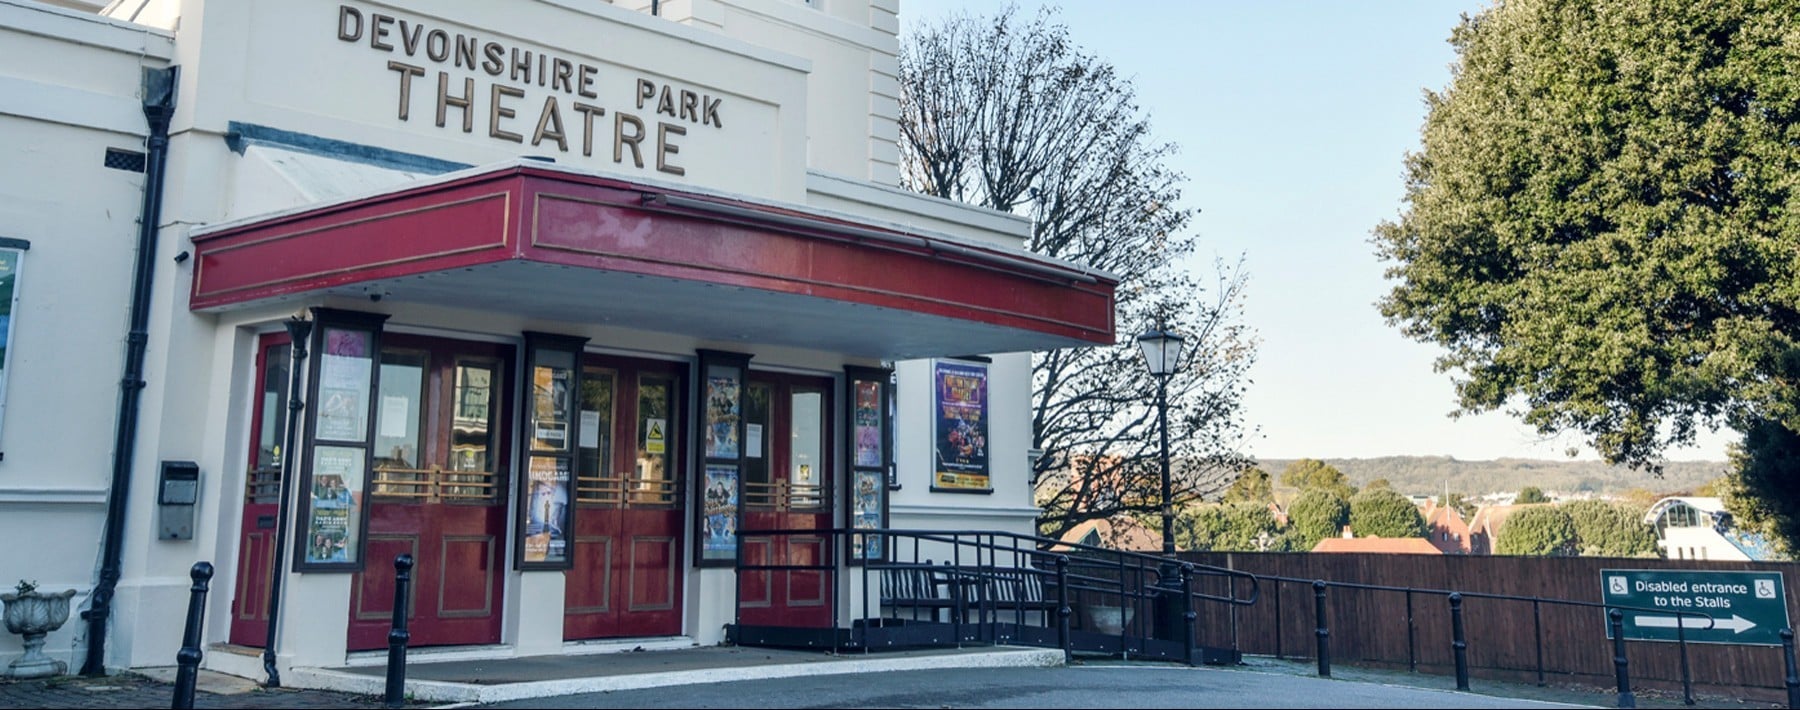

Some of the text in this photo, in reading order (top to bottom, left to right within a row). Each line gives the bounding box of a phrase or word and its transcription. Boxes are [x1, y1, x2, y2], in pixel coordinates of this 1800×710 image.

[337, 5, 723, 128] DEVONSHIRE PARK
[387, 60, 688, 177] THEATRE
[1635, 580, 1748, 595] Disabled entrance
[1654, 596, 1731, 609] to the Stalls
